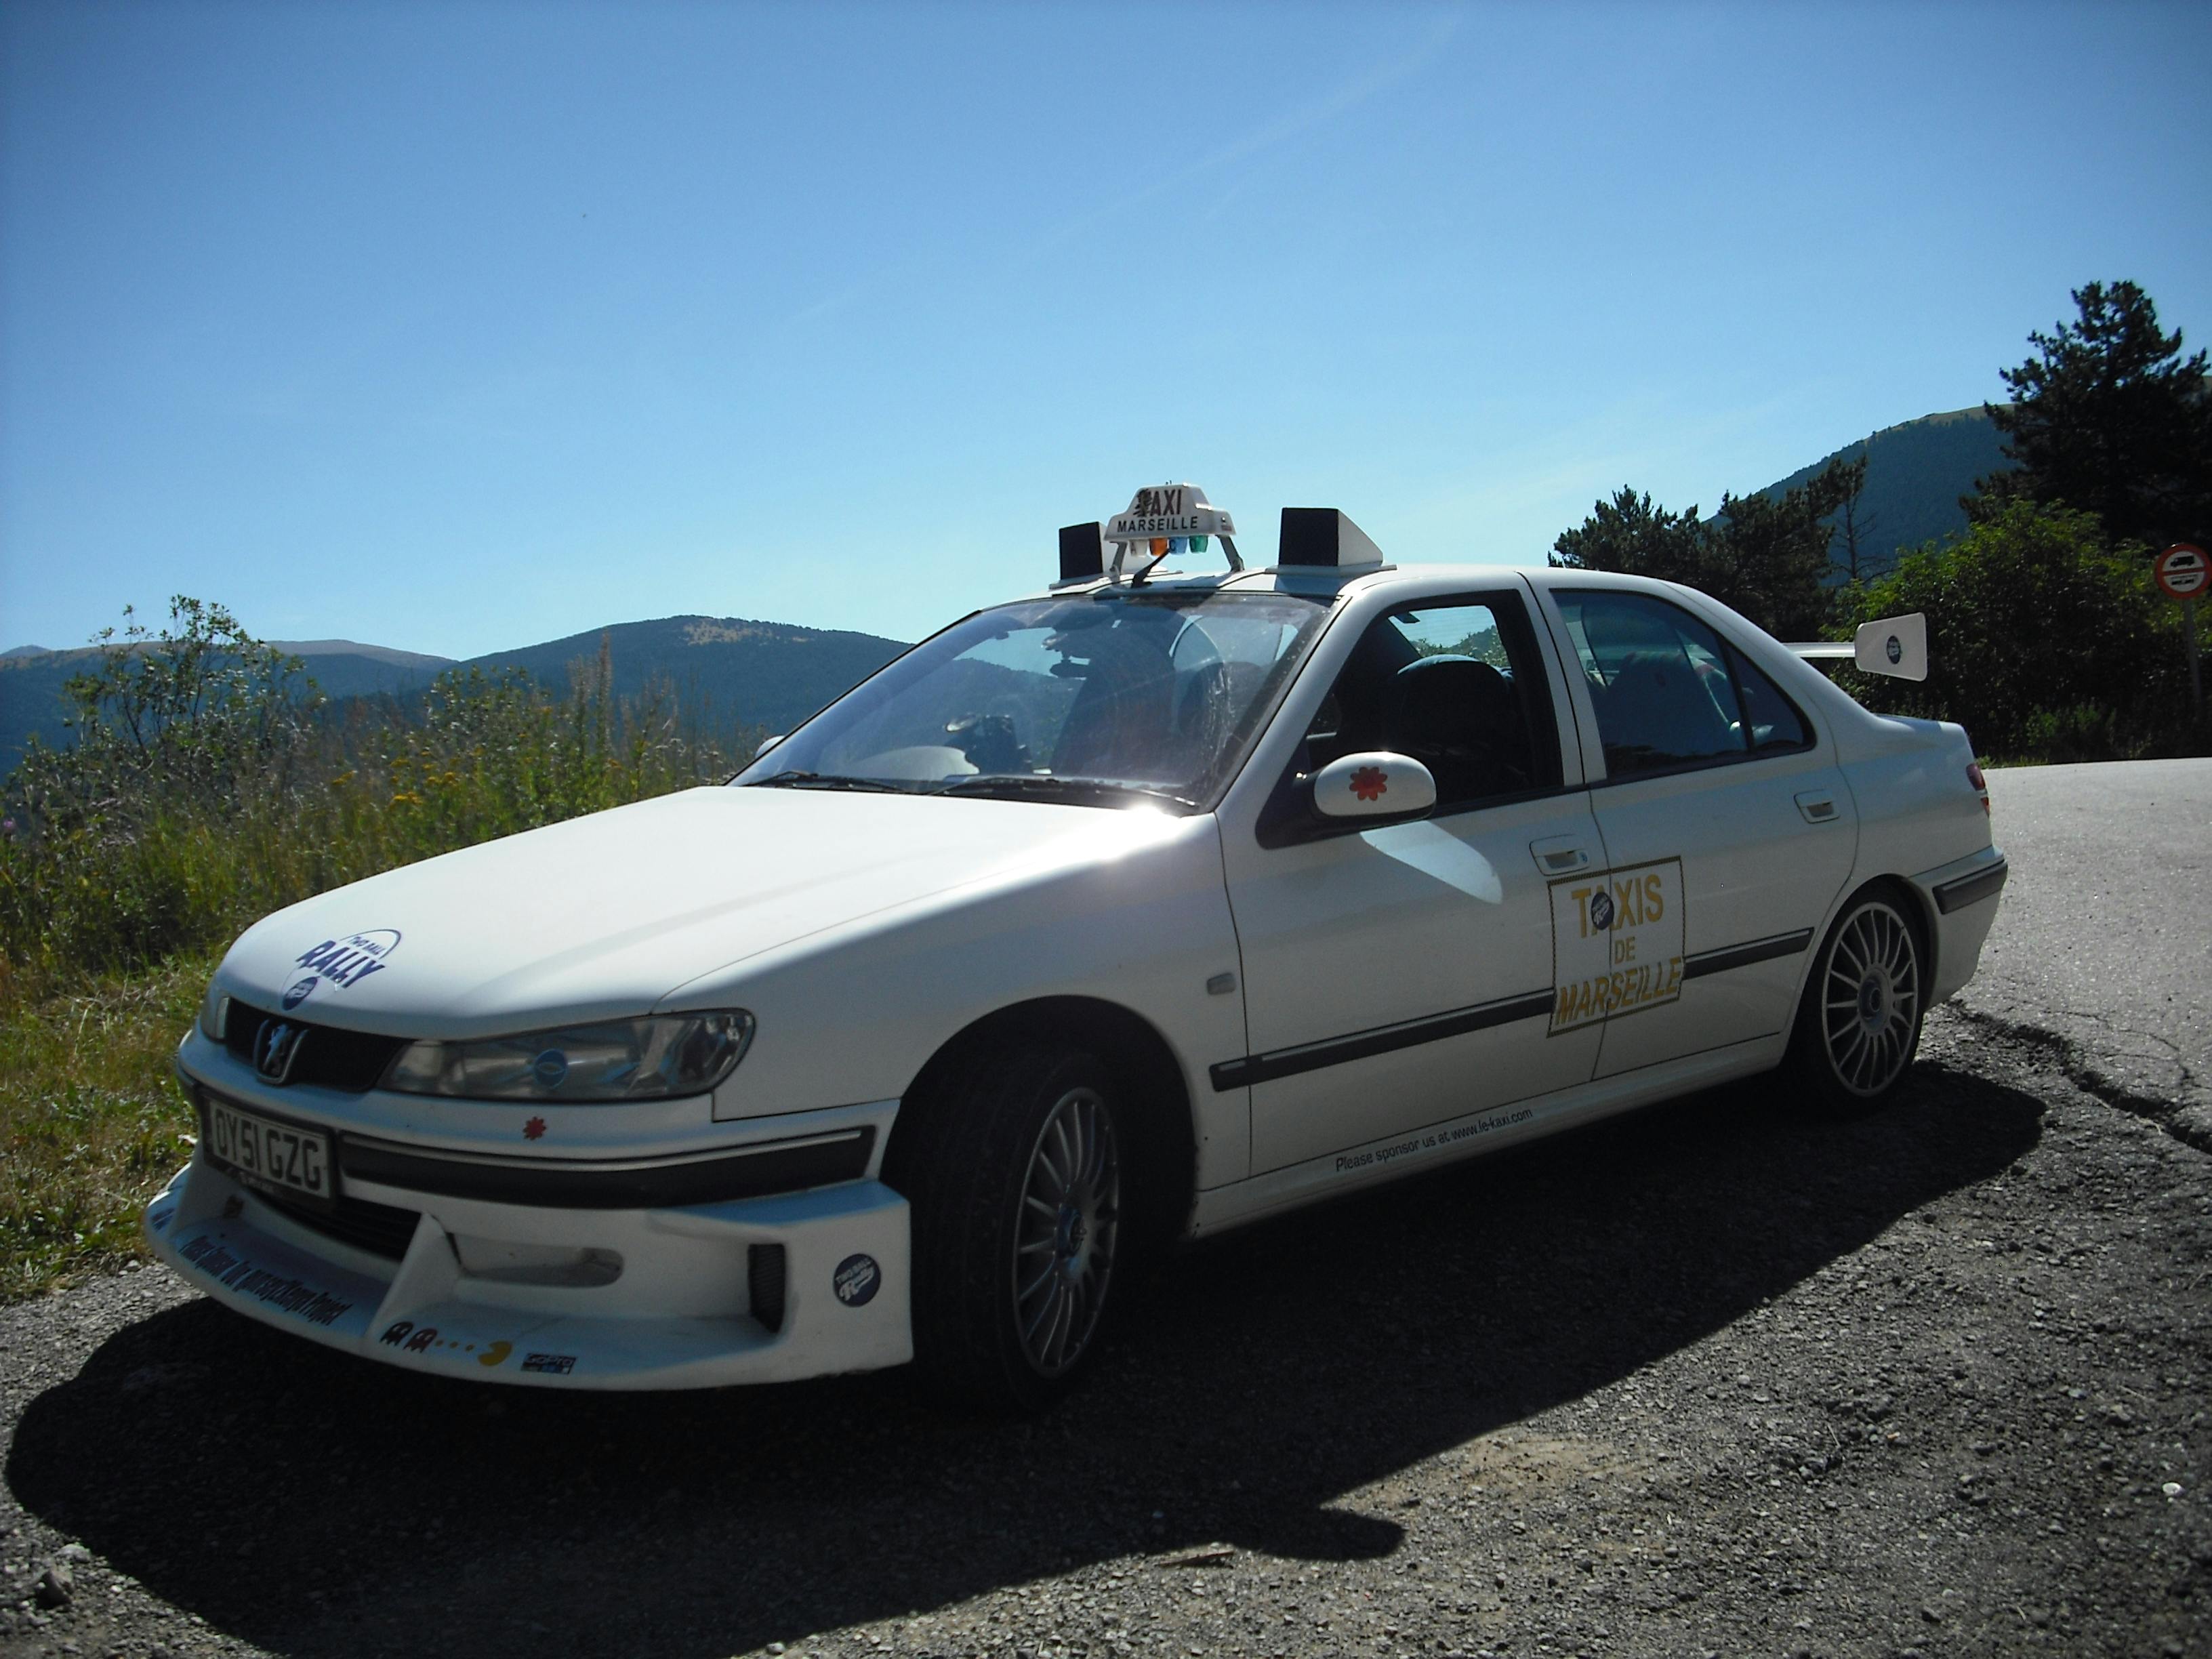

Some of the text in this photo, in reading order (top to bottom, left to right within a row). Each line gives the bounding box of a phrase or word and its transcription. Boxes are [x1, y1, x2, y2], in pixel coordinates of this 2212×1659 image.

[1118, 516, 1198, 532] MARSEILLE
[295, 940, 386, 989] RALLY
[1614, 937, 1635, 964] DE
[1555, 956, 1681, 1025] MARSEILLE
[1335, 1153, 1373, 1172] Please
[1376, 1140, 1419, 1164] sponsor
[1422, 1136, 1437, 1149] us
[1438, 1130, 1451, 1145] at
